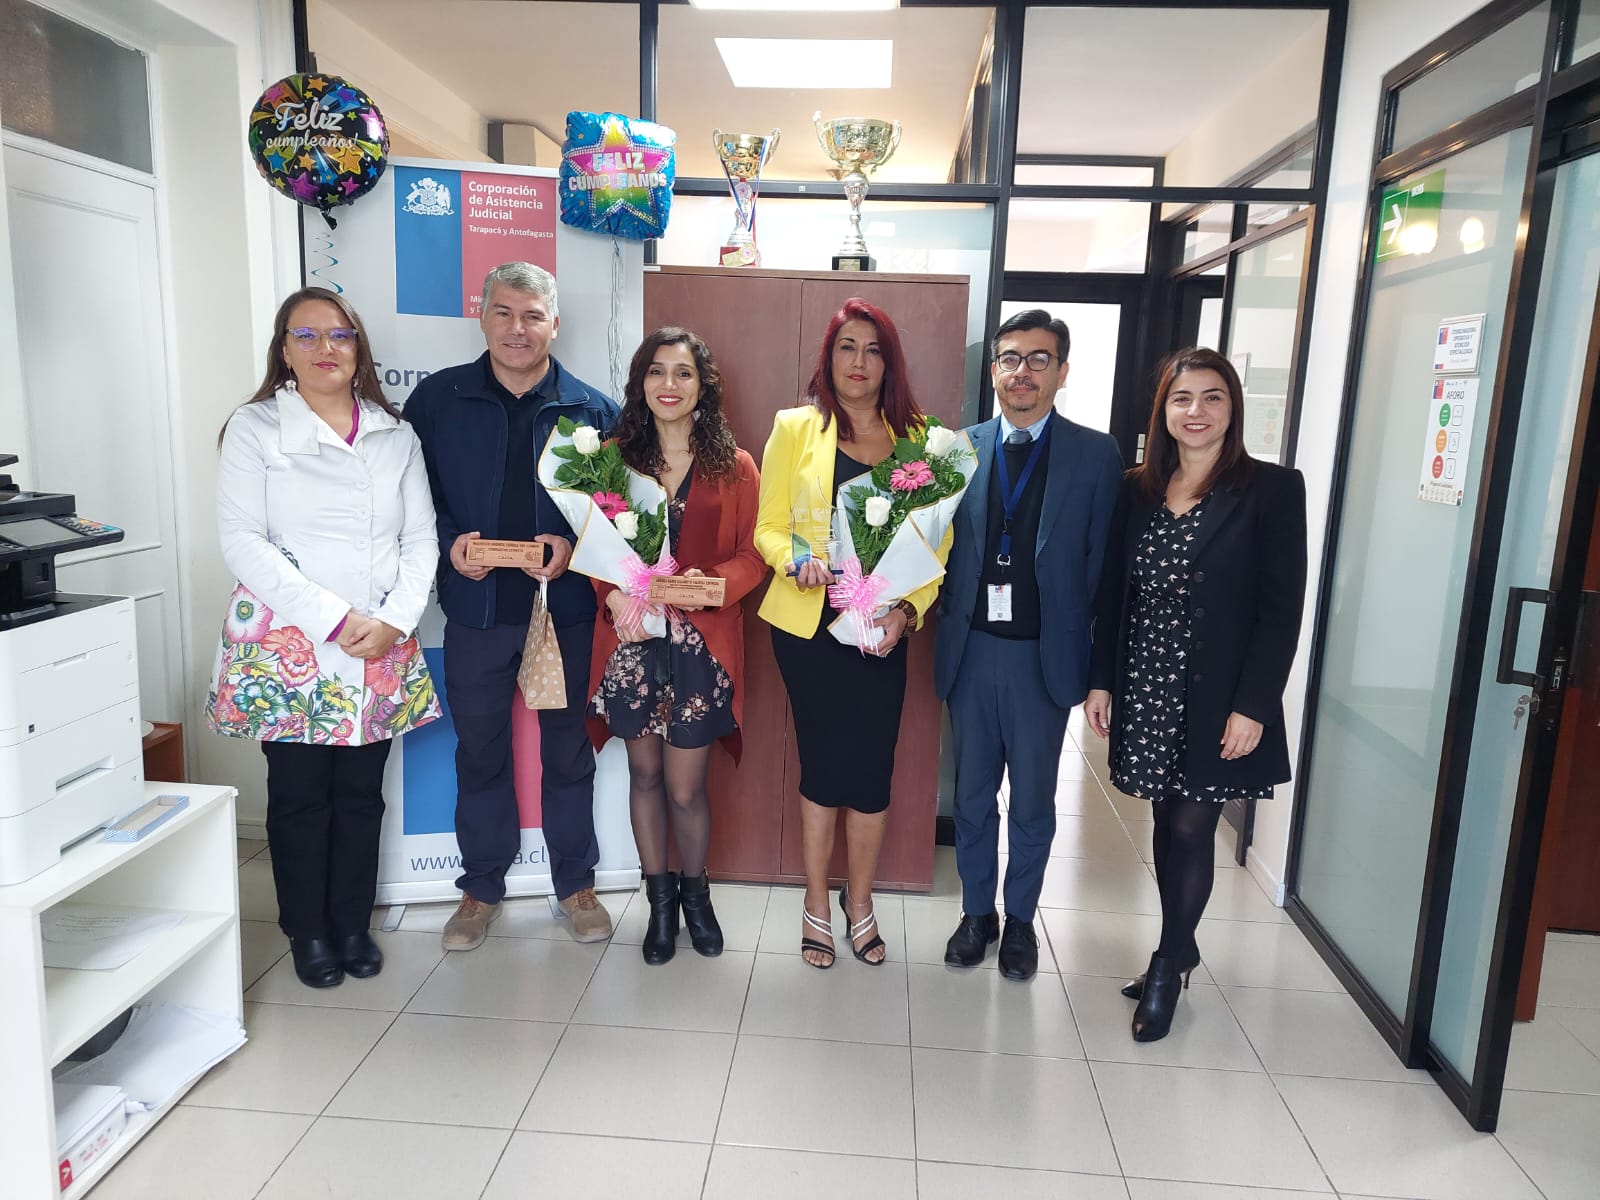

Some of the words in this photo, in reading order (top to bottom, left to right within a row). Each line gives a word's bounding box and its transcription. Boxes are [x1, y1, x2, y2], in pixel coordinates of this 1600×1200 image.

[275, 97, 344, 131] Feliz
[592, 151, 645, 172] FELIZ
[468, 181, 537, 197] Corporación
[469, 194, 483, 205] de
[486, 195, 543, 209] Asistencia
[468, 207, 513, 220] Judicial
[468, 225, 502, 235] Tarapacá
[503, 228, 508, 236] y
[509, 228, 554, 238] Antofagasta
